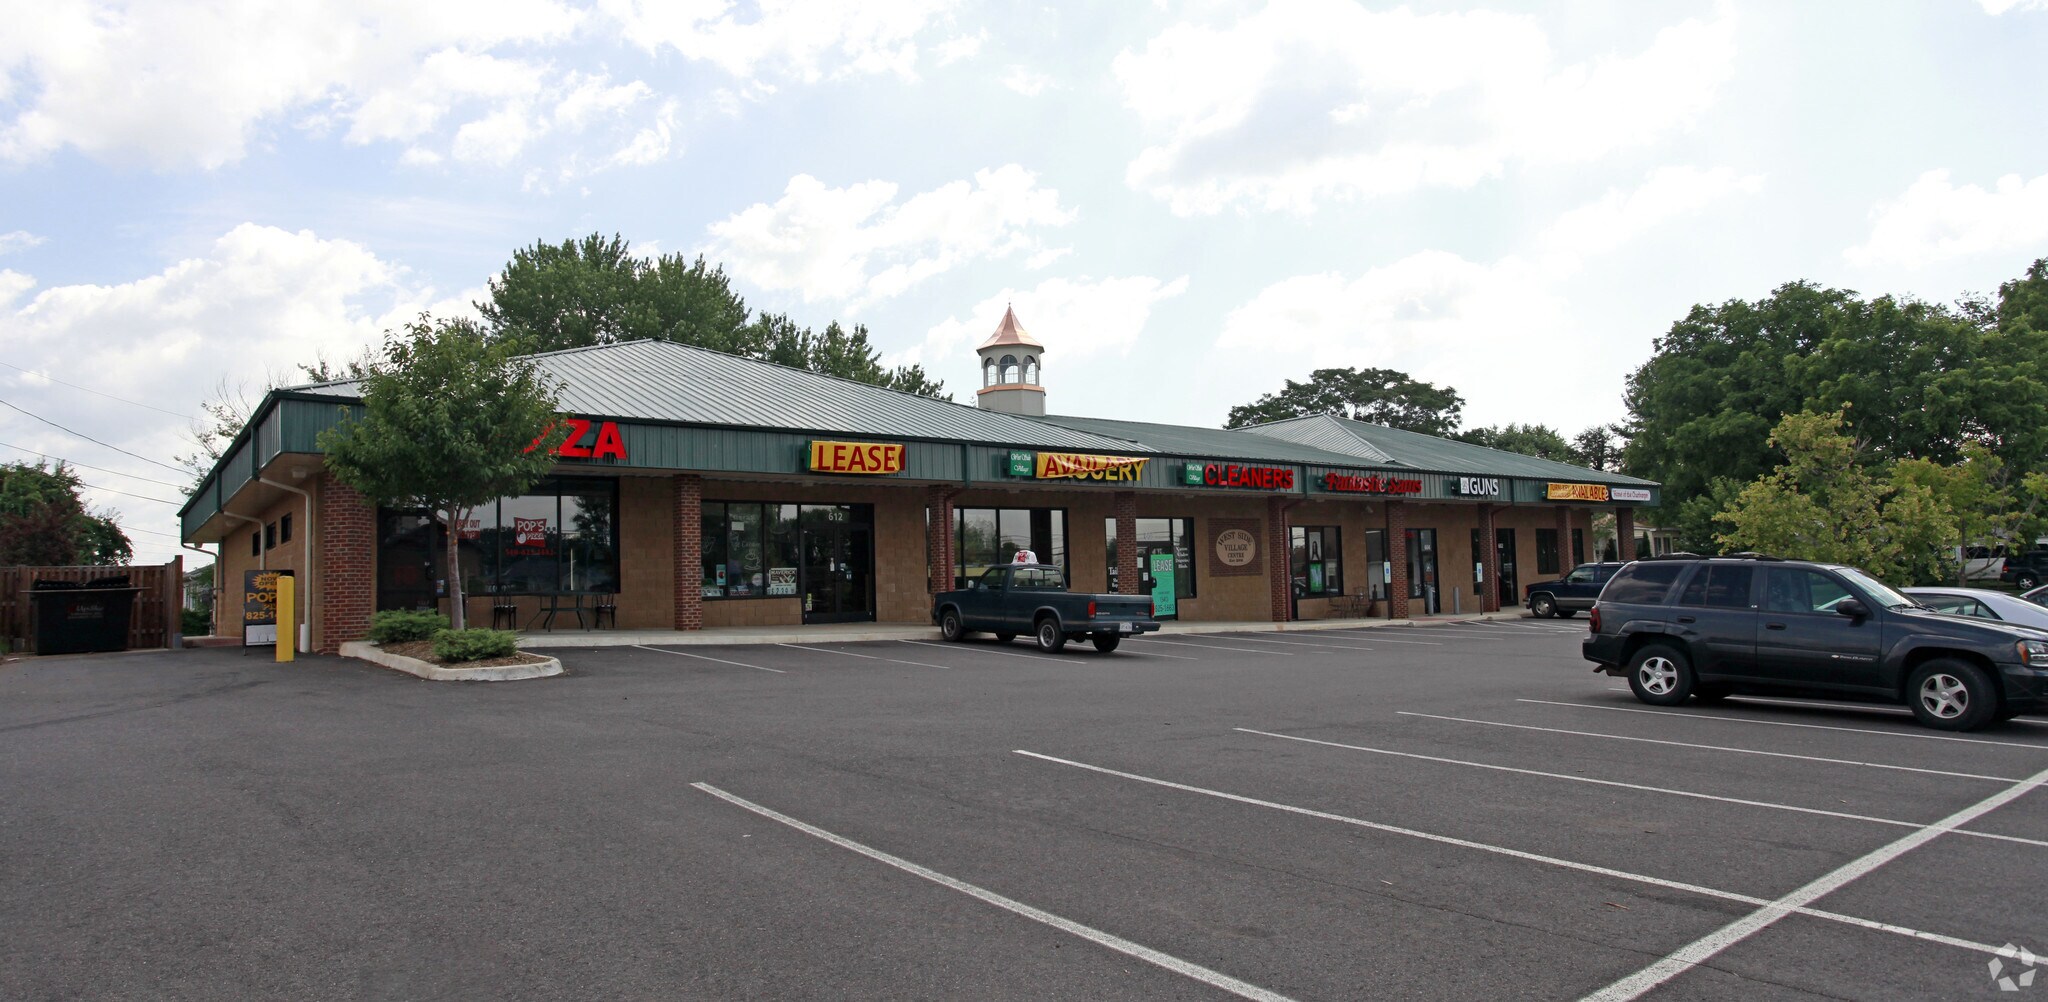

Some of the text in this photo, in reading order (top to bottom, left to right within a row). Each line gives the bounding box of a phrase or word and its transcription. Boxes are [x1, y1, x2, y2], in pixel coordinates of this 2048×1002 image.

[817, 445, 896, 472] LEASE
[1204, 463, 1294, 489] CLEANERS
[1325, 472, 1422, 494] Fantastic Sams
[1469, 477, 1499, 496] GUNS
[1571, 484, 1606, 500] AVAILABLE
[828, 512, 843, 521] 612
[517, 520, 545, 531] POP'S
[1218, 531, 1236, 546] WEST
[1224, 544, 1248, 552] VILLAGE
[1153, 559, 1173, 573] LEASE
